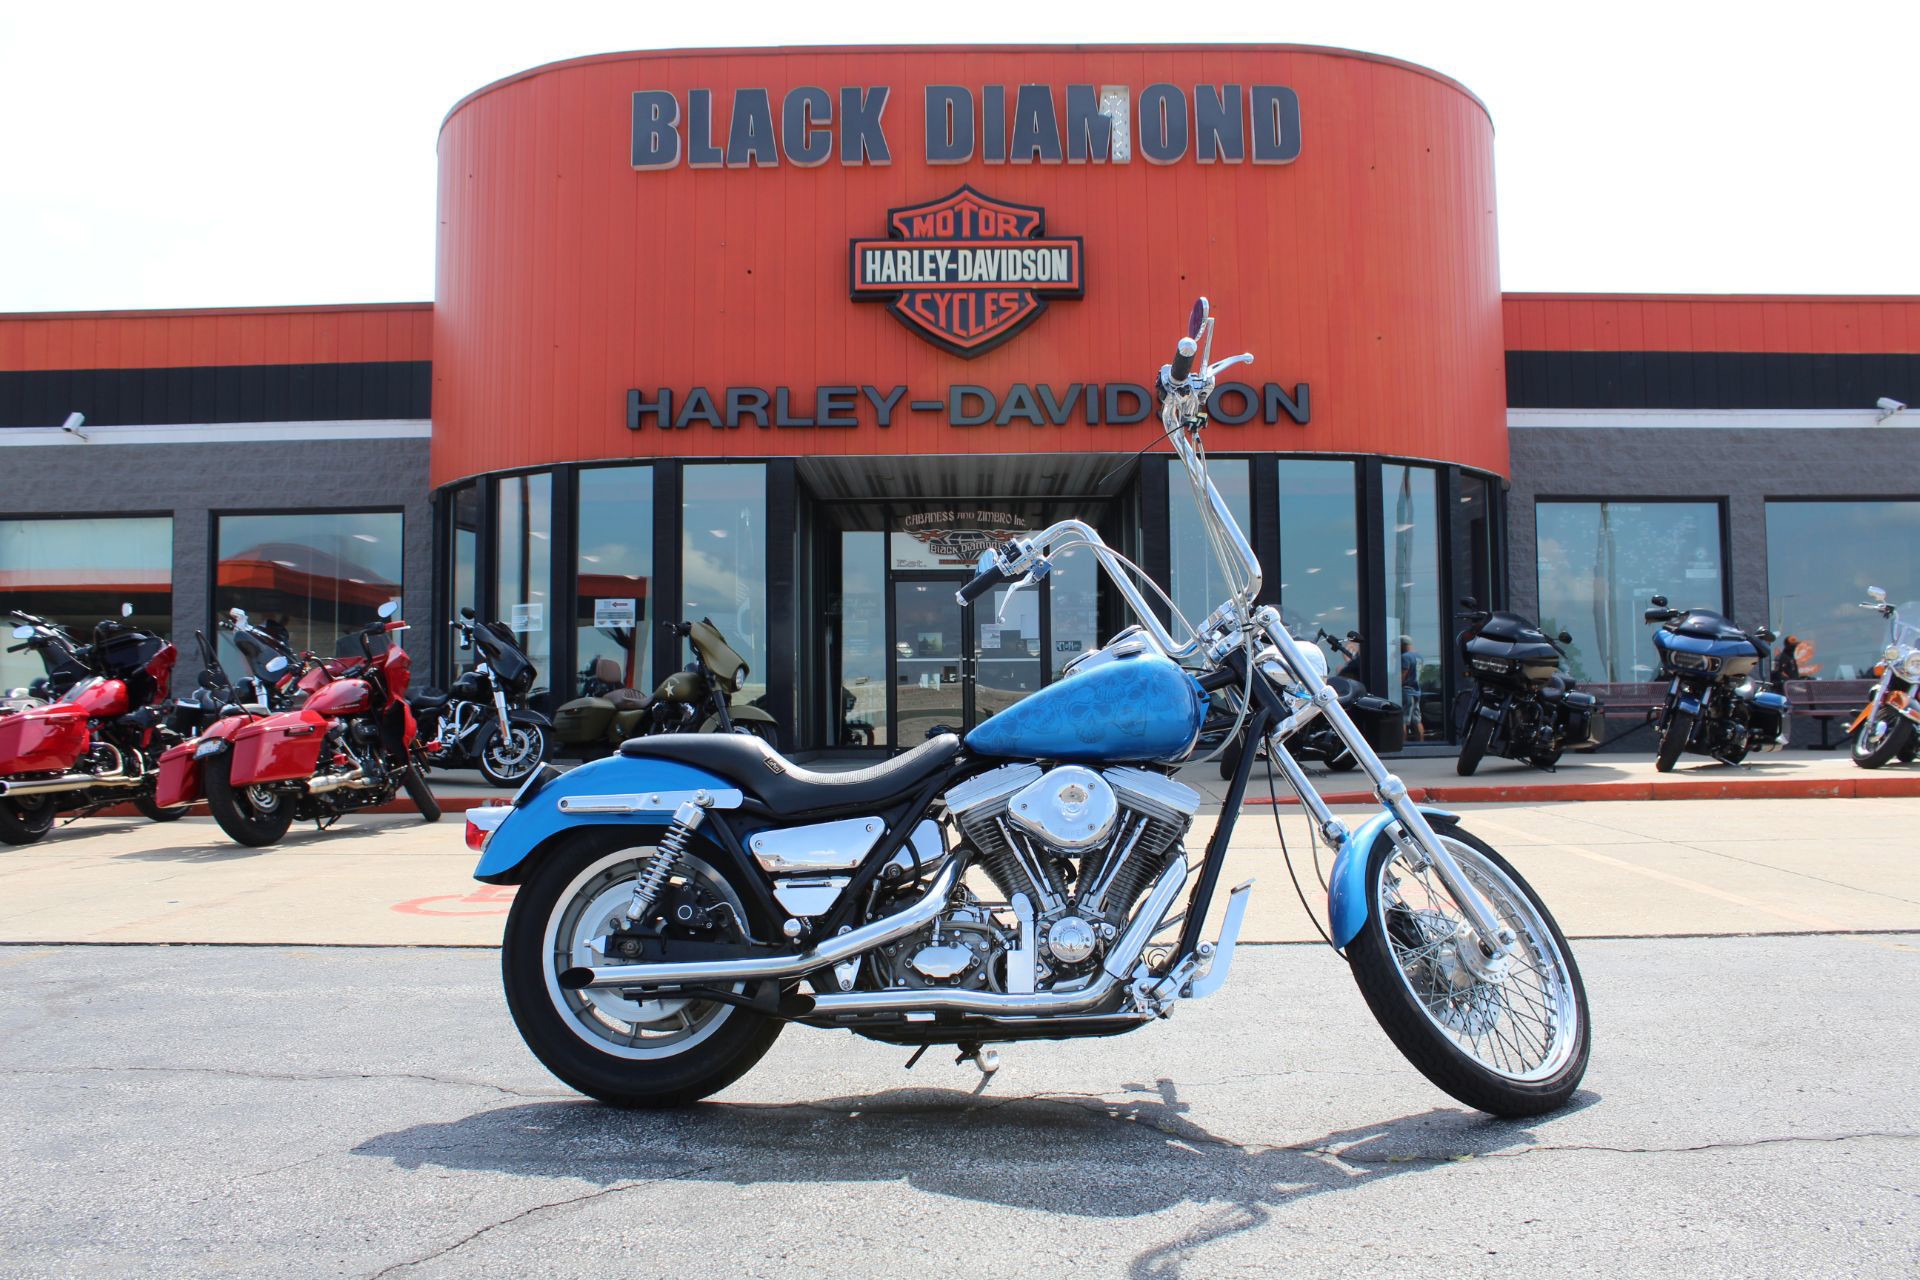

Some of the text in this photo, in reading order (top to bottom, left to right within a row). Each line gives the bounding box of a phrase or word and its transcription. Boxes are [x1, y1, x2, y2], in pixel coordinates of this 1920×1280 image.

[631, 83, 1302, 171] BLACK DIAMOND
[913, 200, 1020, 239] MOTOR
[865, 248, 1069, 283] HARLEY-DAVIDSON
[914, 292, 1020, 337] CYCLES
[626, 382, 1311, 430] HARLEY-DAVIDON
